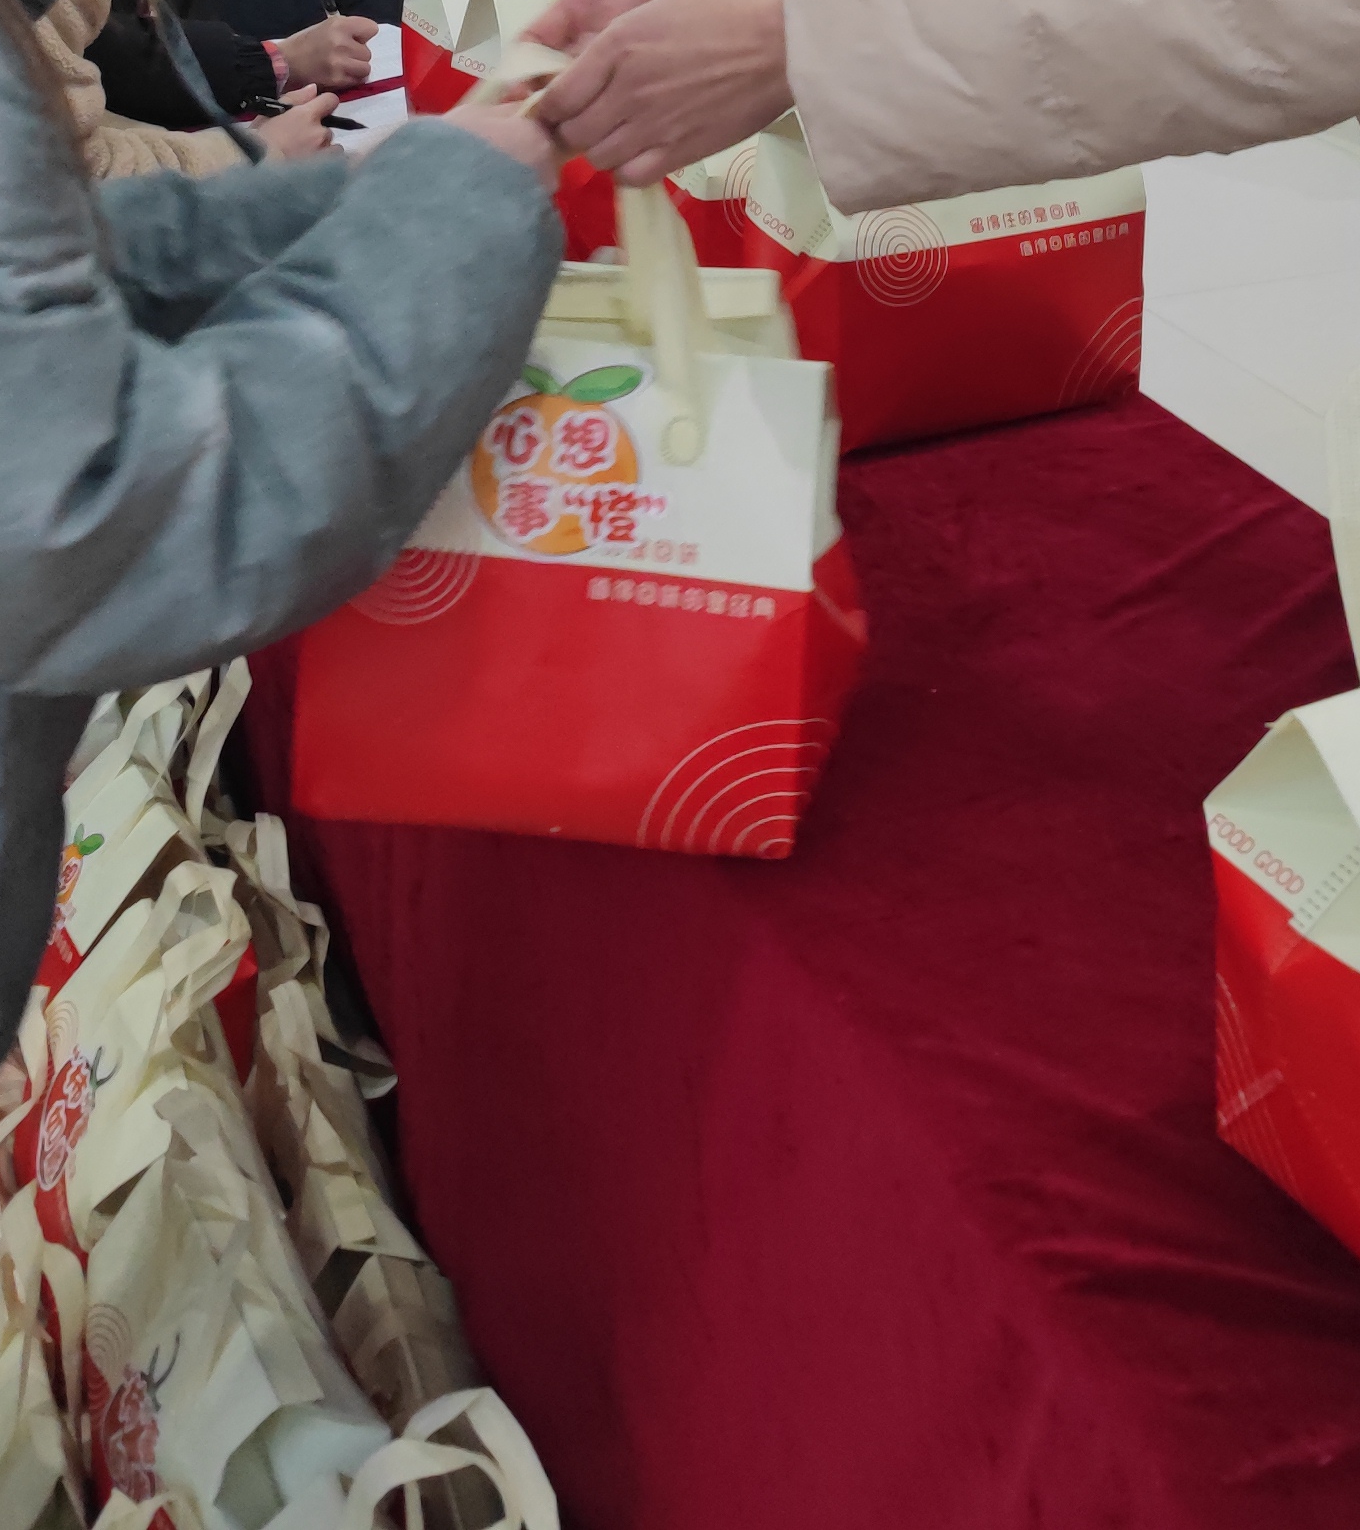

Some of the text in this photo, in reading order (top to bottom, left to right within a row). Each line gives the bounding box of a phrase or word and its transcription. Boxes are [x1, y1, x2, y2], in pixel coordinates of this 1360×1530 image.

[762, 212, 796, 241] GOOD
[492, 411, 610, 471] 心想
[1207, 812, 1306, 895] FOOD GOOD
